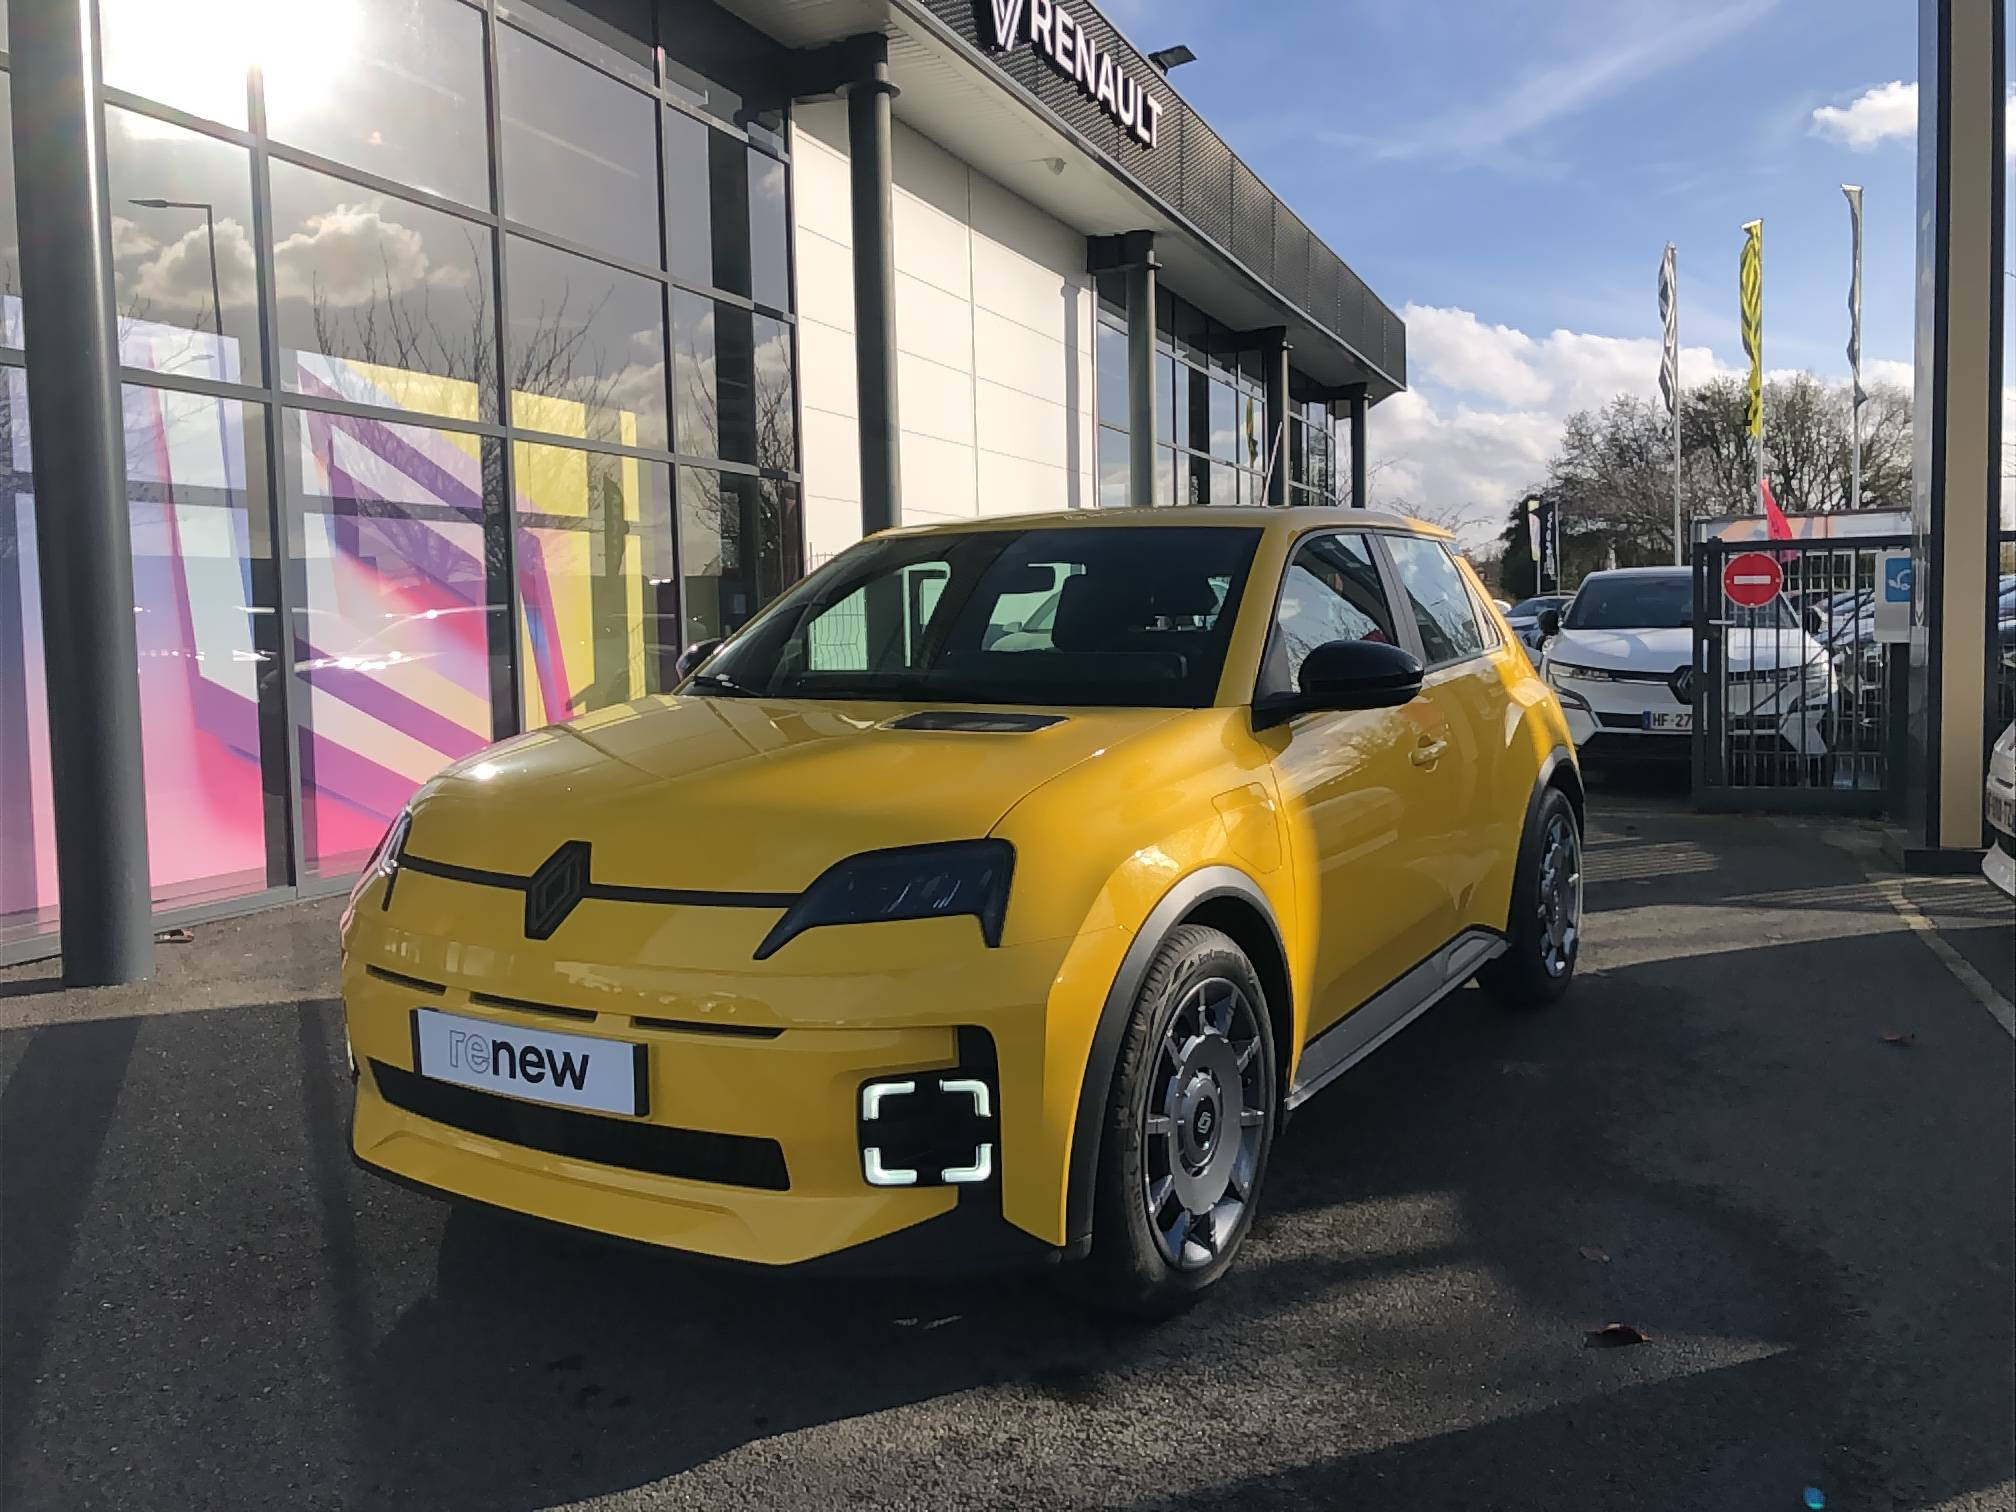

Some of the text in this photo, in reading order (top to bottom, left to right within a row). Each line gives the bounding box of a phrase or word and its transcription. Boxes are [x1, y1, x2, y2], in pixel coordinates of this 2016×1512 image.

[1030, 0, 1163, 148] RENAULT
[1653, 714, 1692, 727] HF-27
[449, 1030, 590, 1091] renew
